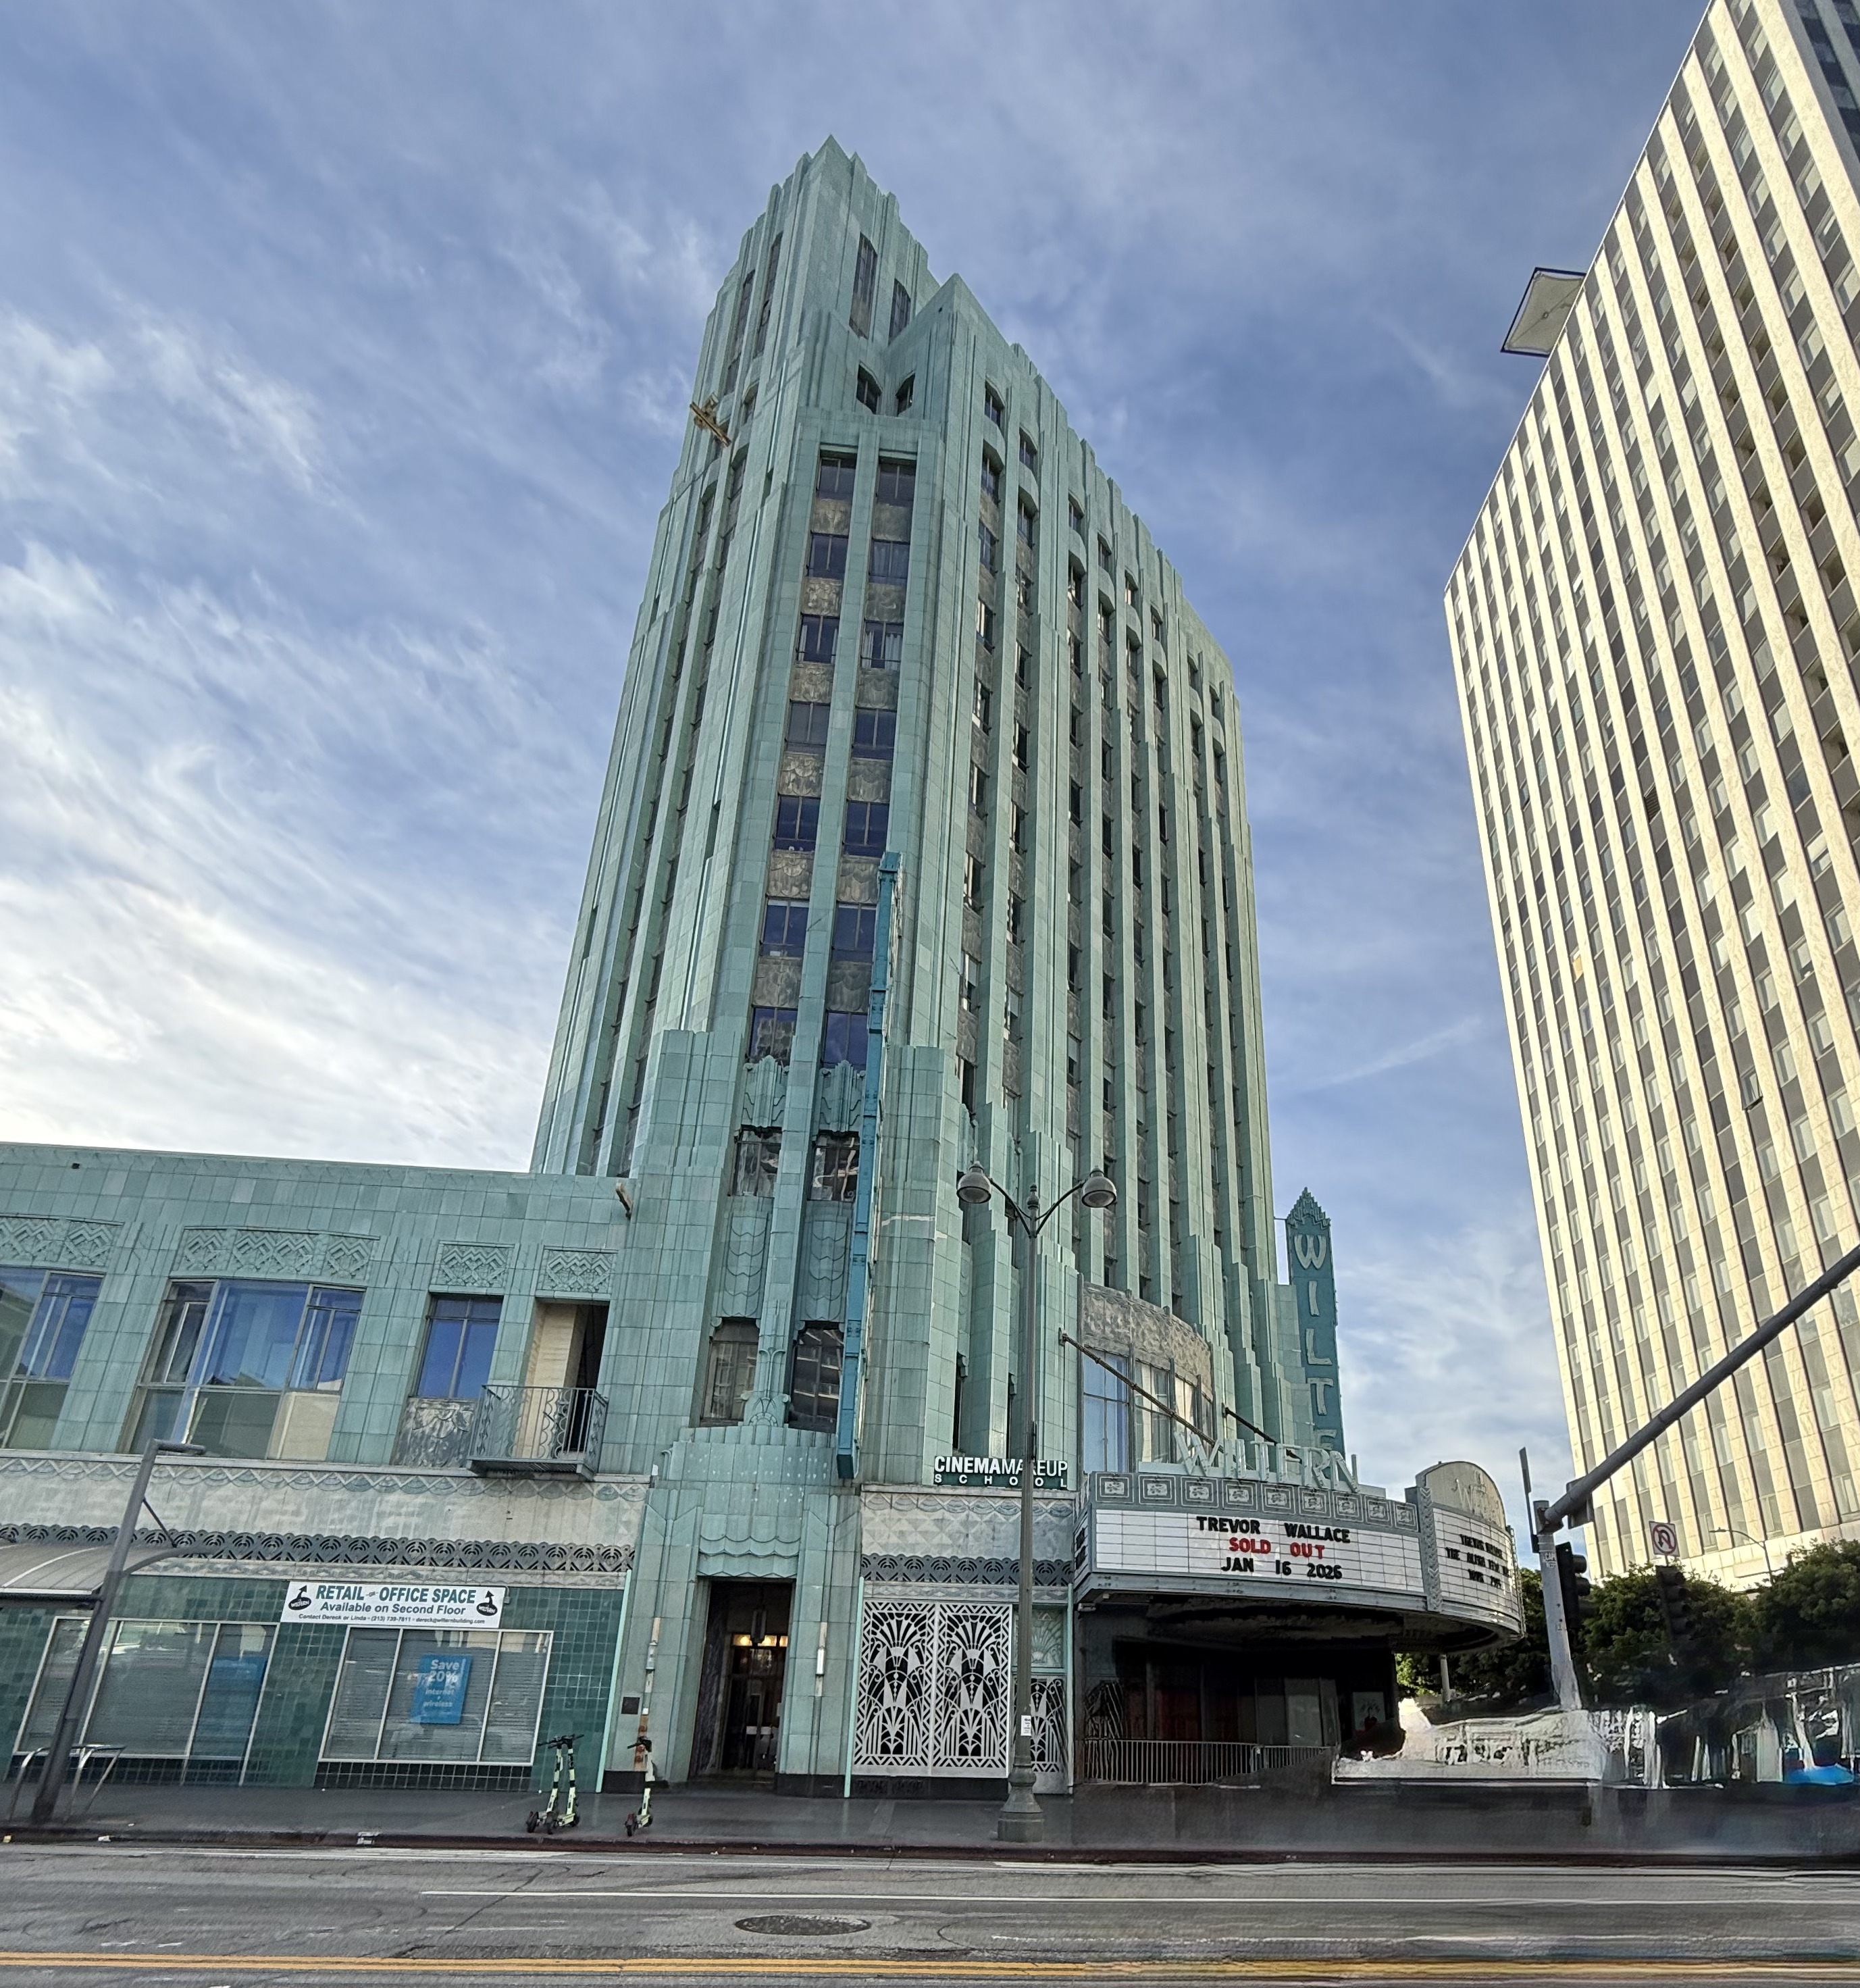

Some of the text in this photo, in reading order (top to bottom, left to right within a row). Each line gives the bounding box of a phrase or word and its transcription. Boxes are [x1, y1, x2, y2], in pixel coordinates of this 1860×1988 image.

[934, 1456, 1068, 1477] CINEMAMAEUP
[1173, 1430, 1359, 1494] WILTERN
[934, 1475, 1067, 1487] SCHOOL
[1197, 1517, 1351, 1544] TREVOR WALLACE
[1229, 1537, 1325, 1560] SOLD OUT
[1220, 1557, 1343, 1580] JAN 16 2026
[315, 1585, 477, 1604] RETAIL OFFICE SPACE
[320, 1602, 371, 1612] Available
[374, 1605, 389, 1613] on
[392, 1604, 434, 1614] Second
[436, 1605, 466, 1615] Floor
[430, 1659, 460, 1671] Save
[428, 1670, 459, 1683] 20%
